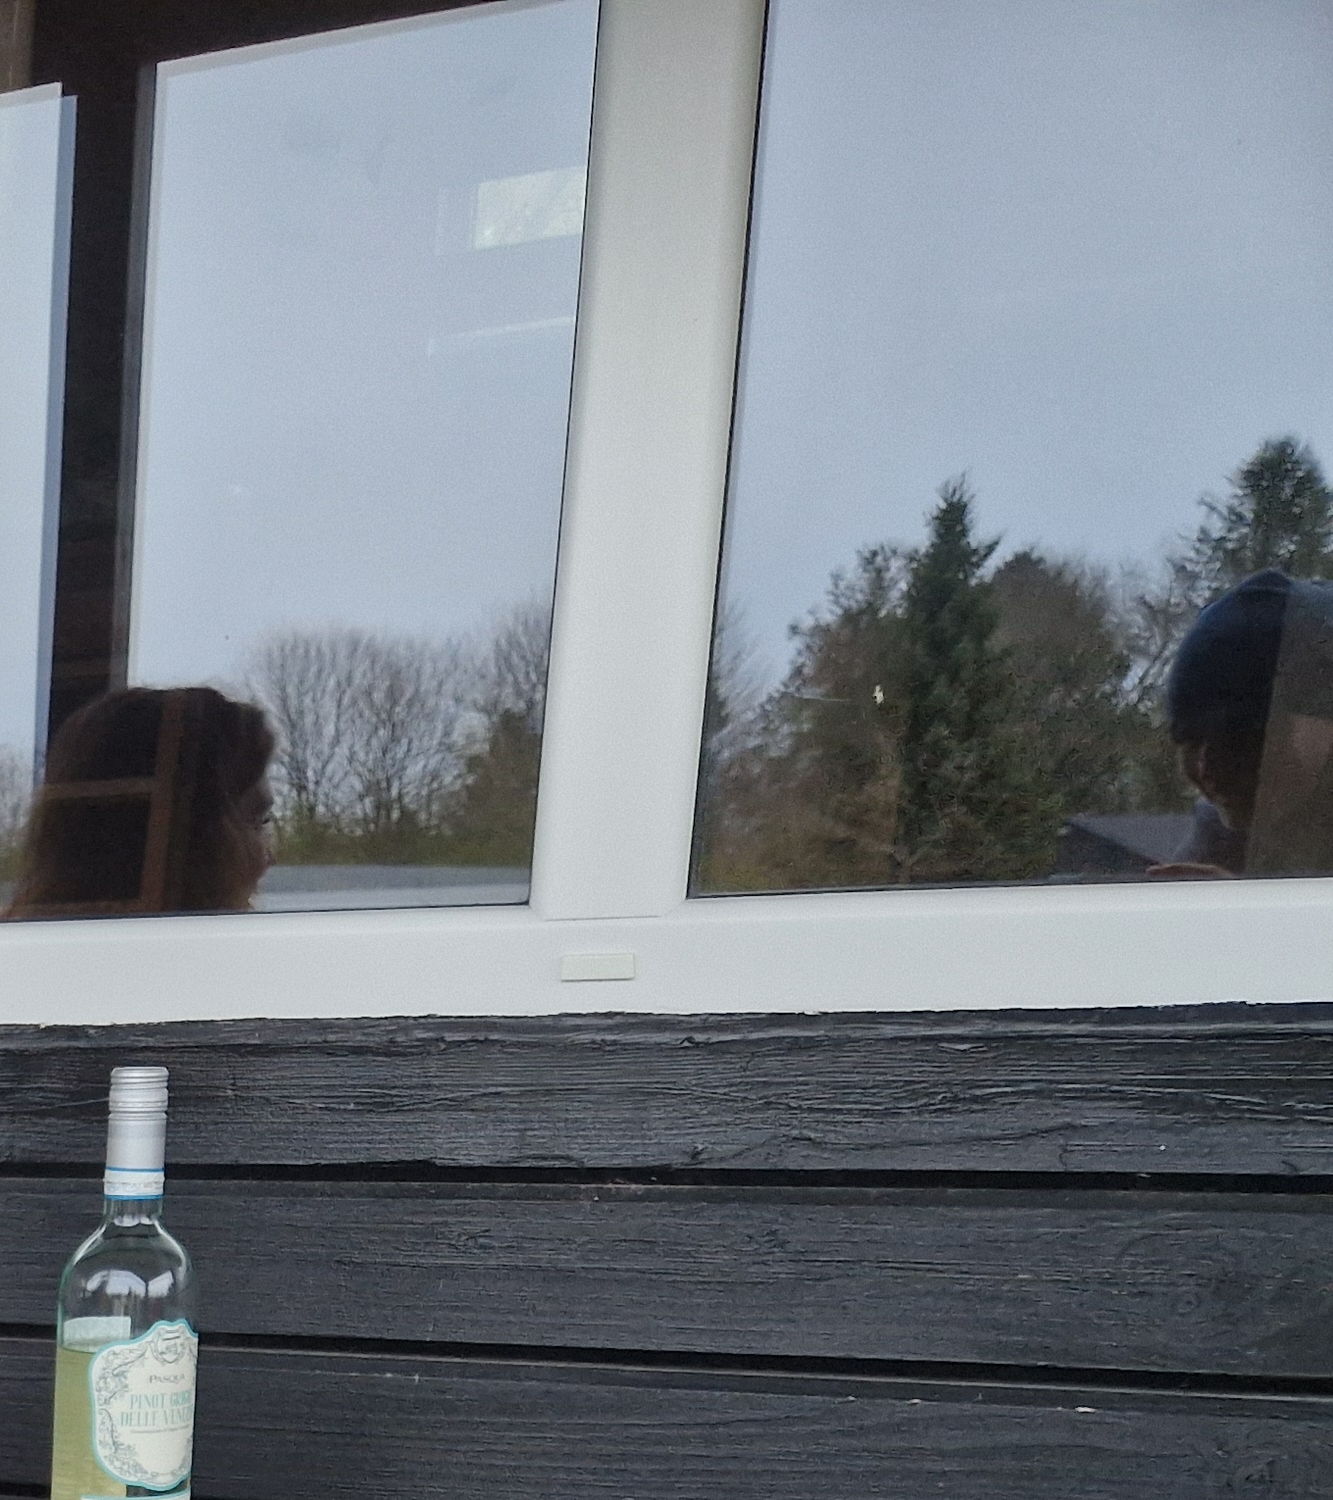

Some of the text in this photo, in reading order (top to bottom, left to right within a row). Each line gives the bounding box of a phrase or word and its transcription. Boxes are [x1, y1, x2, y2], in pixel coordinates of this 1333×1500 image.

[149, 1373, 186, 1384] PASQUA
[130, 1393, 167, 1410] PINOT
[121, 1410, 158, 1427] DELLE
